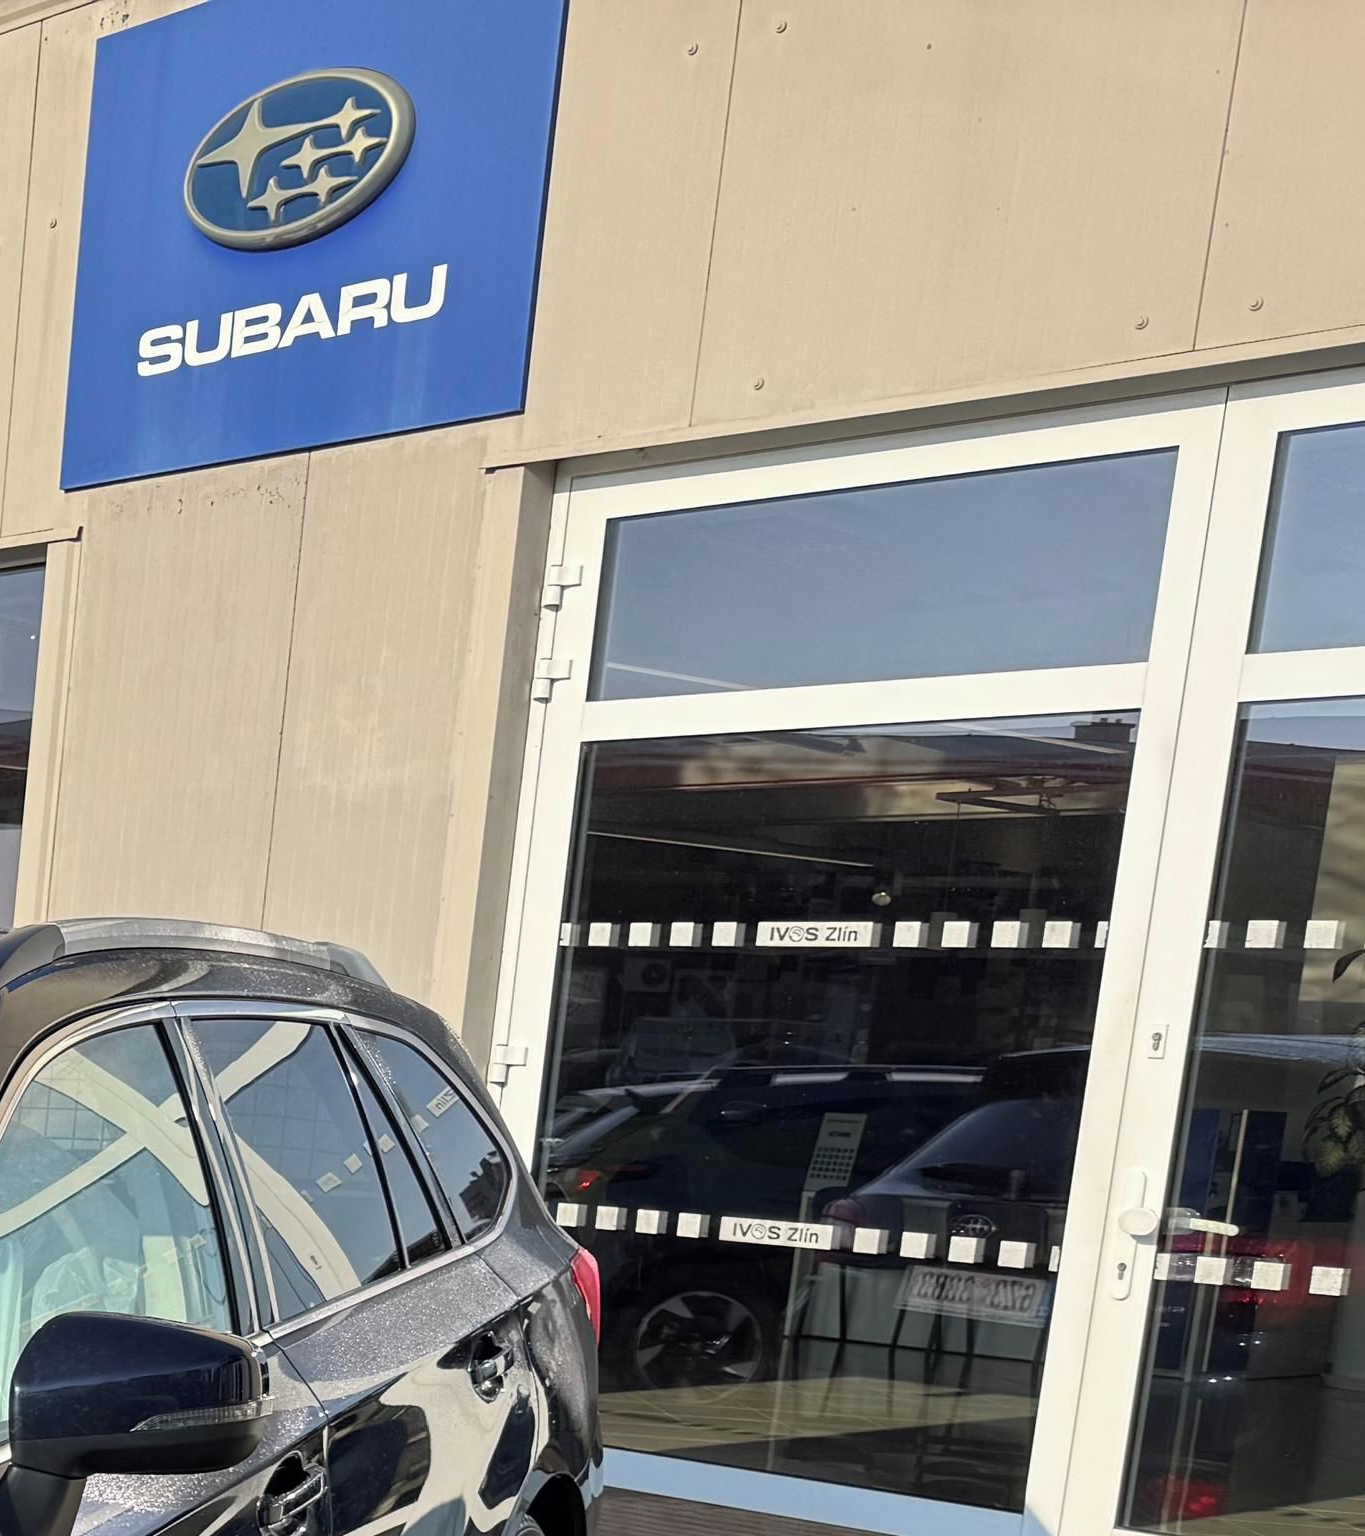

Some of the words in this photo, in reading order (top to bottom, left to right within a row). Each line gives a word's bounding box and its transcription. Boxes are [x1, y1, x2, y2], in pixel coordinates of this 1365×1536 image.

[137, 263, 448, 377] SUBARU
[769, 926, 819, 943] IVOS
[825, 926, 858, 942] Zlín
[732, 1222, 781, 1240] IVOS
[787, 1228, 819, 1244] Zlín
